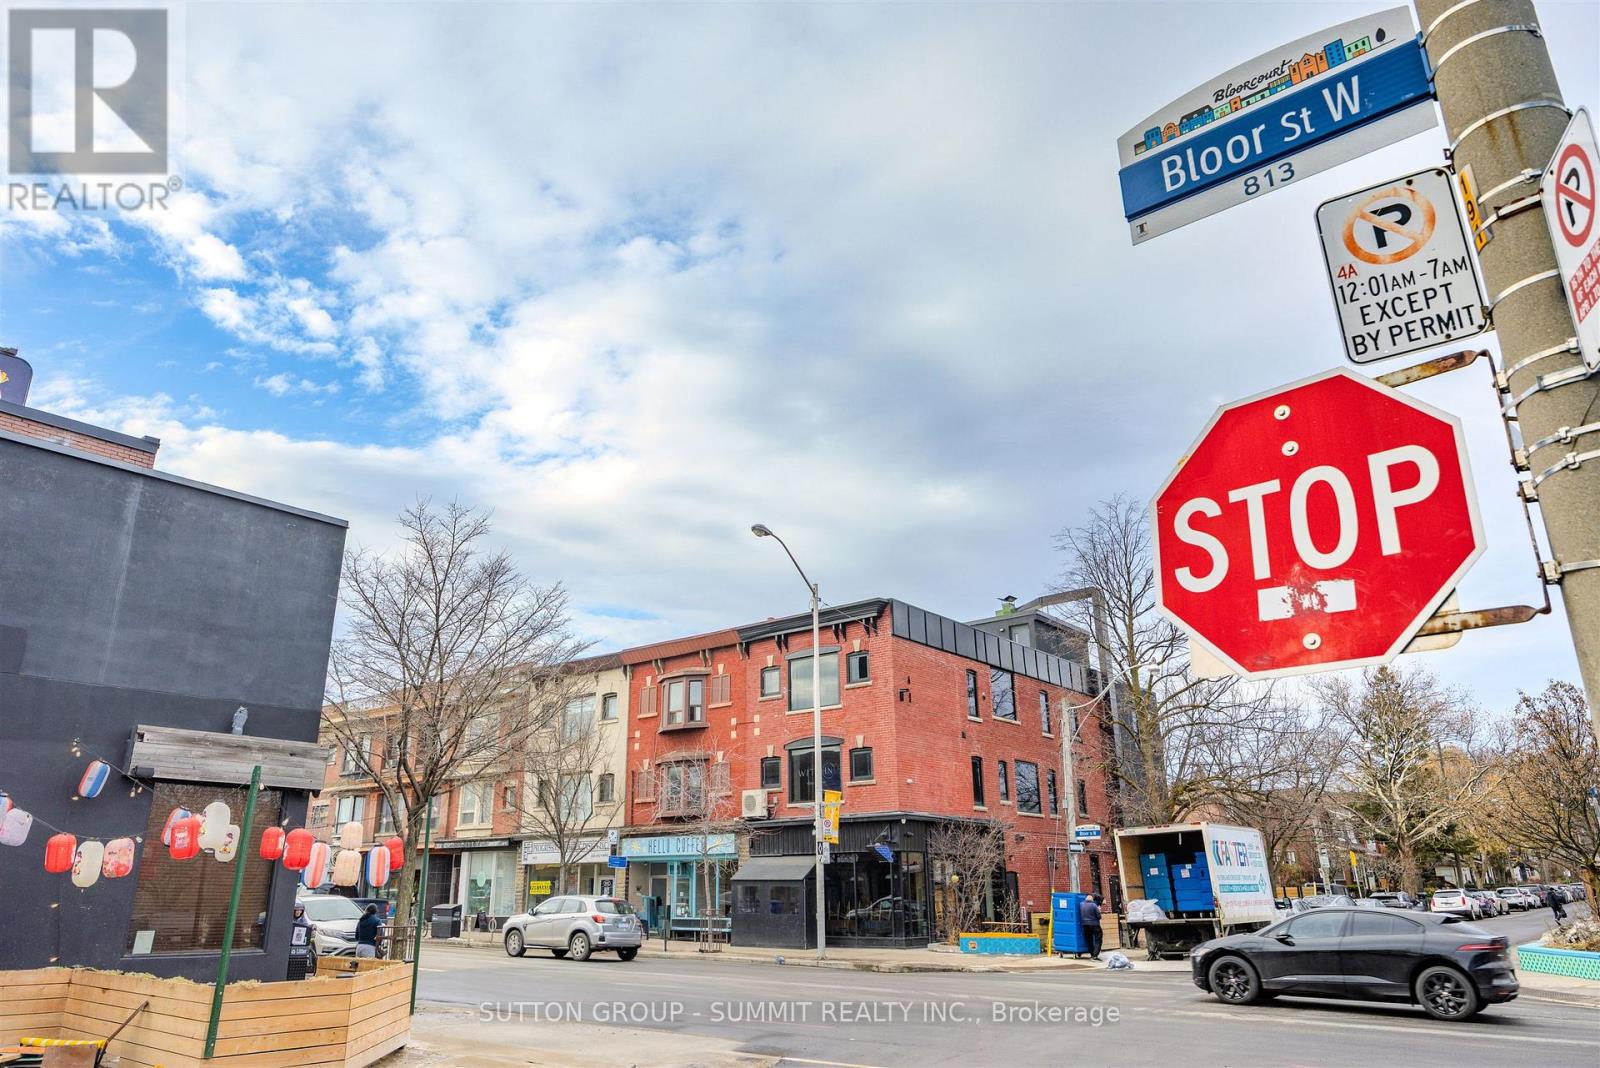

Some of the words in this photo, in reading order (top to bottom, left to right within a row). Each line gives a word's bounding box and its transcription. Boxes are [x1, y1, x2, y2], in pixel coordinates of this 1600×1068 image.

[1212, 59, 1293, 103] Bloorcourt
[1161, 123, 1265, 193] Bloor
[1280, 107, 1315, 142] St
[1322, 75, 1360, 122] W
[1244, 162, 1295, 196] 813
[1337, 264, 1358, 280] 4A
[1360, 282, 1453, 326] EXCEPT
[1351, 329, 1381, 356] BY
[1389, 304, 1475, 346] PERMIT
[1173, 445, 1440, 593] STOP
